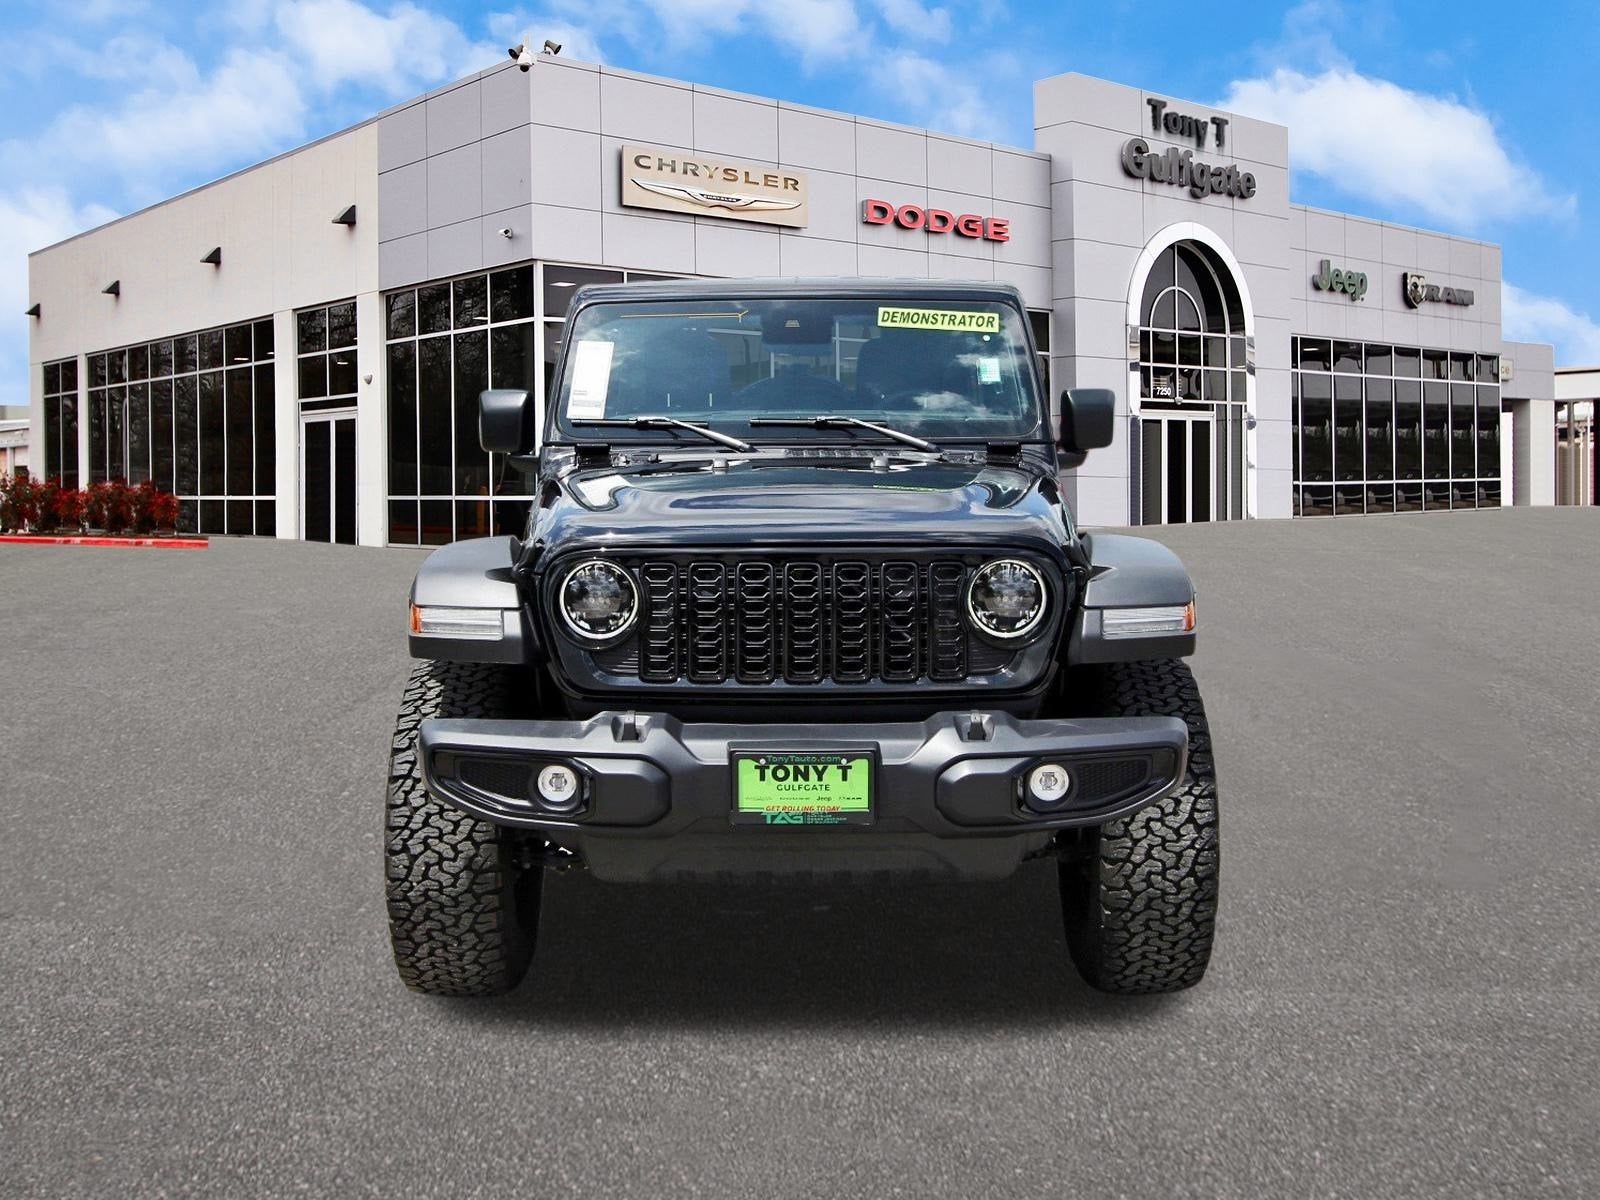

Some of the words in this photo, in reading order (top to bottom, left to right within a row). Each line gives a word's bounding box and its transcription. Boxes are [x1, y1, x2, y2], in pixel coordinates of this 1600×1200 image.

[1147, 98, 1208, 148] Tony
[1210, 116, 1229, 147] T
[633, 153, 801, 193] CHRYSLER
[1121, 137, 1257, 199] Gulfgate
[862, 198, 1010, 242] DODGE
[1312, 259, 1368, 301] Jeep
[1425, 284, 1475, 306] RAM
[881, 310, 996, 329] DEMONSTRATOR
[1156, 387, 1172, 396] 7250
[766, 755, 841, 765] TonyTauto.com
[754, 765, 829, 782] TONY
[837, 765, 853, 782] T
[776, 784, 831, 792] GULFGATE
[761, 812, 804, 824] TAG
